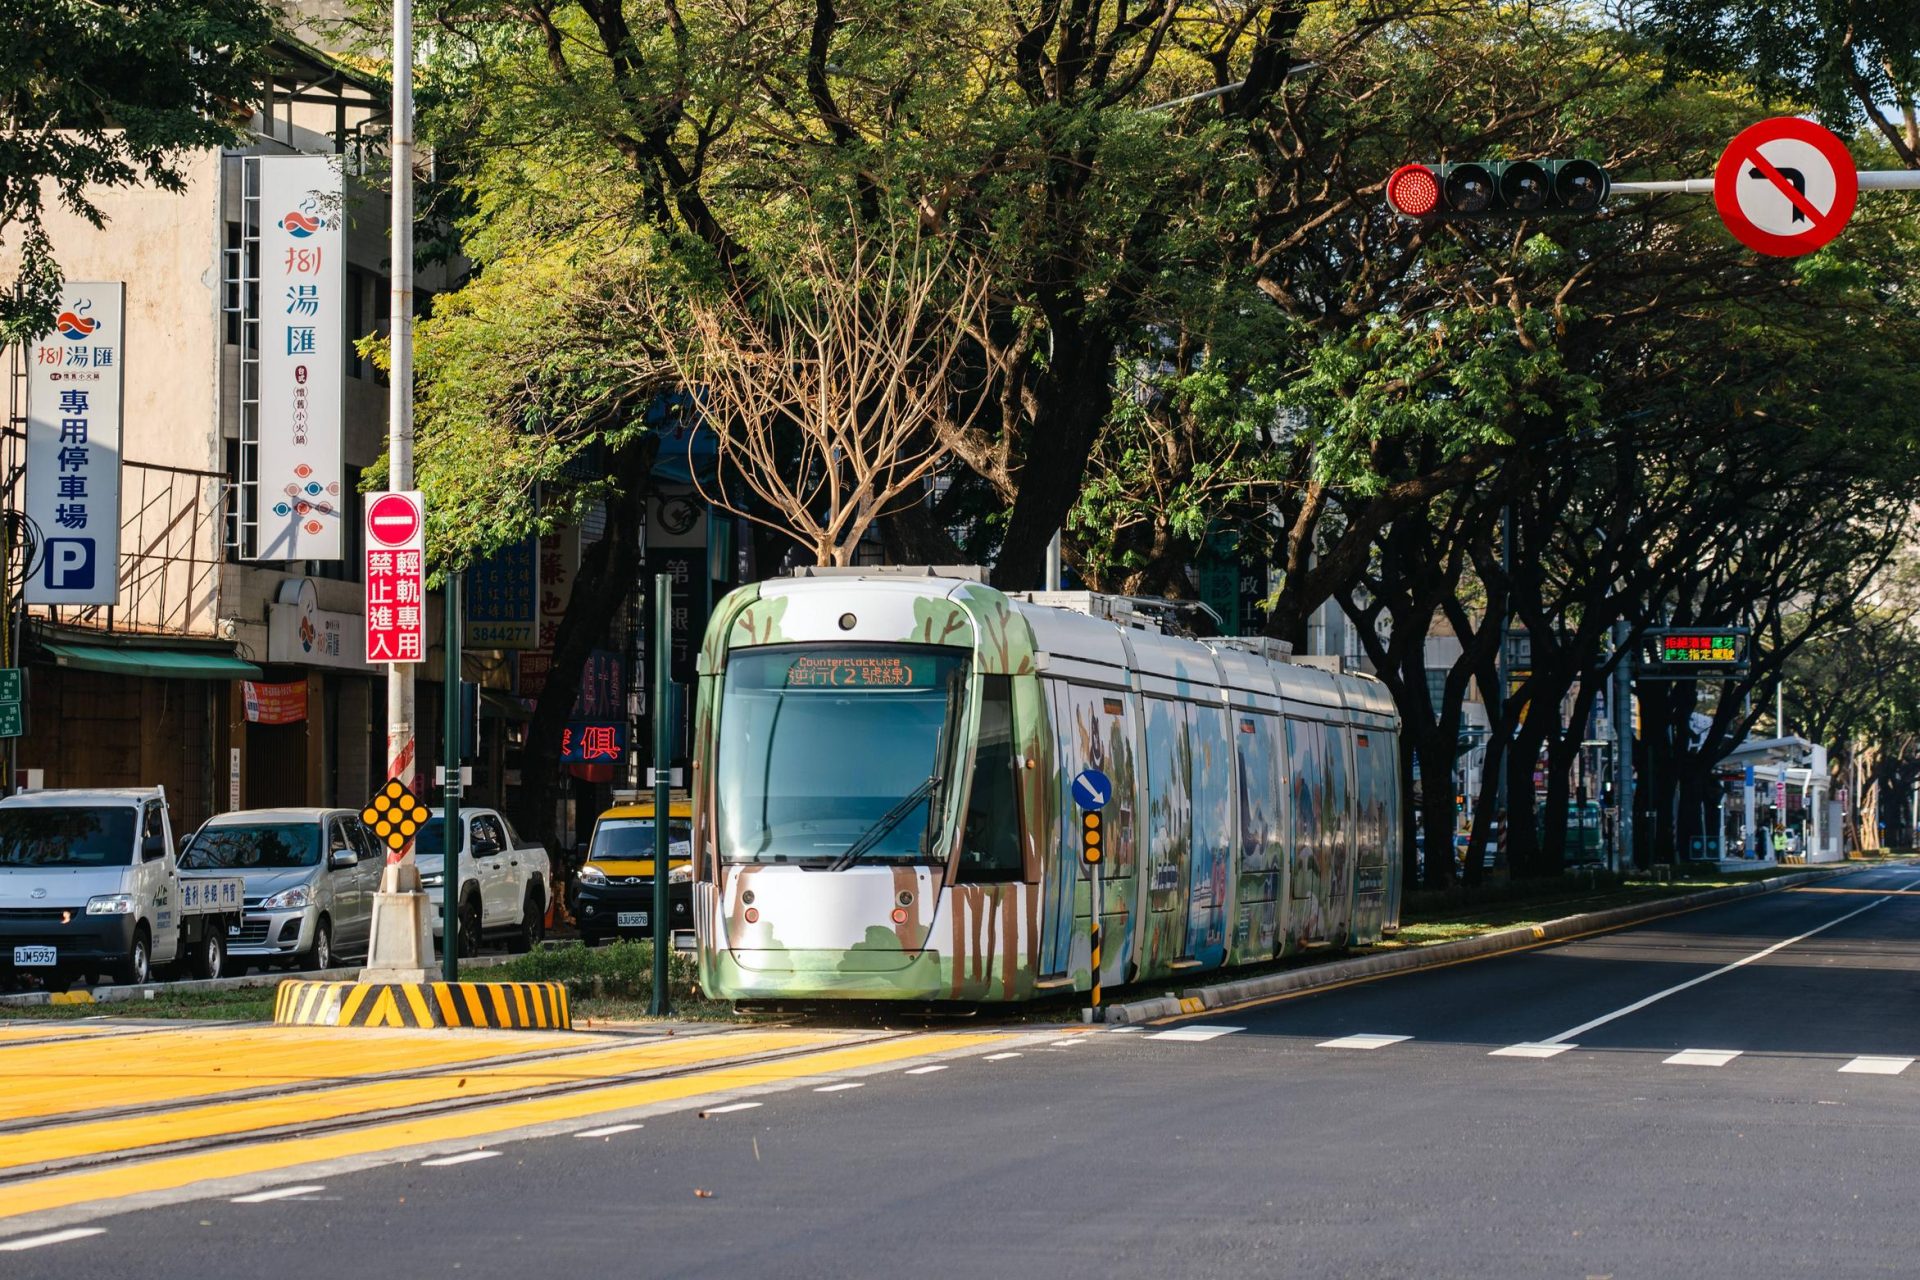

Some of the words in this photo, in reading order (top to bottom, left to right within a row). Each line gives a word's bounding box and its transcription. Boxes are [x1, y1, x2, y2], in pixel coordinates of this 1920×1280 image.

[284, 246, 321, 356] 捌湯匯
[37, 346, 113, 368] 捌湯匯
[55, 389, 89, 529] 專用停車場
[52, 541, 87, 586] P
[369, 551, 393, 658] 禁止進入
[396, 551, 420, 657] 輕軌專用
[472, 627, 531, 642] 3844277
[799, 657, 901, 667] Counterclockwise
